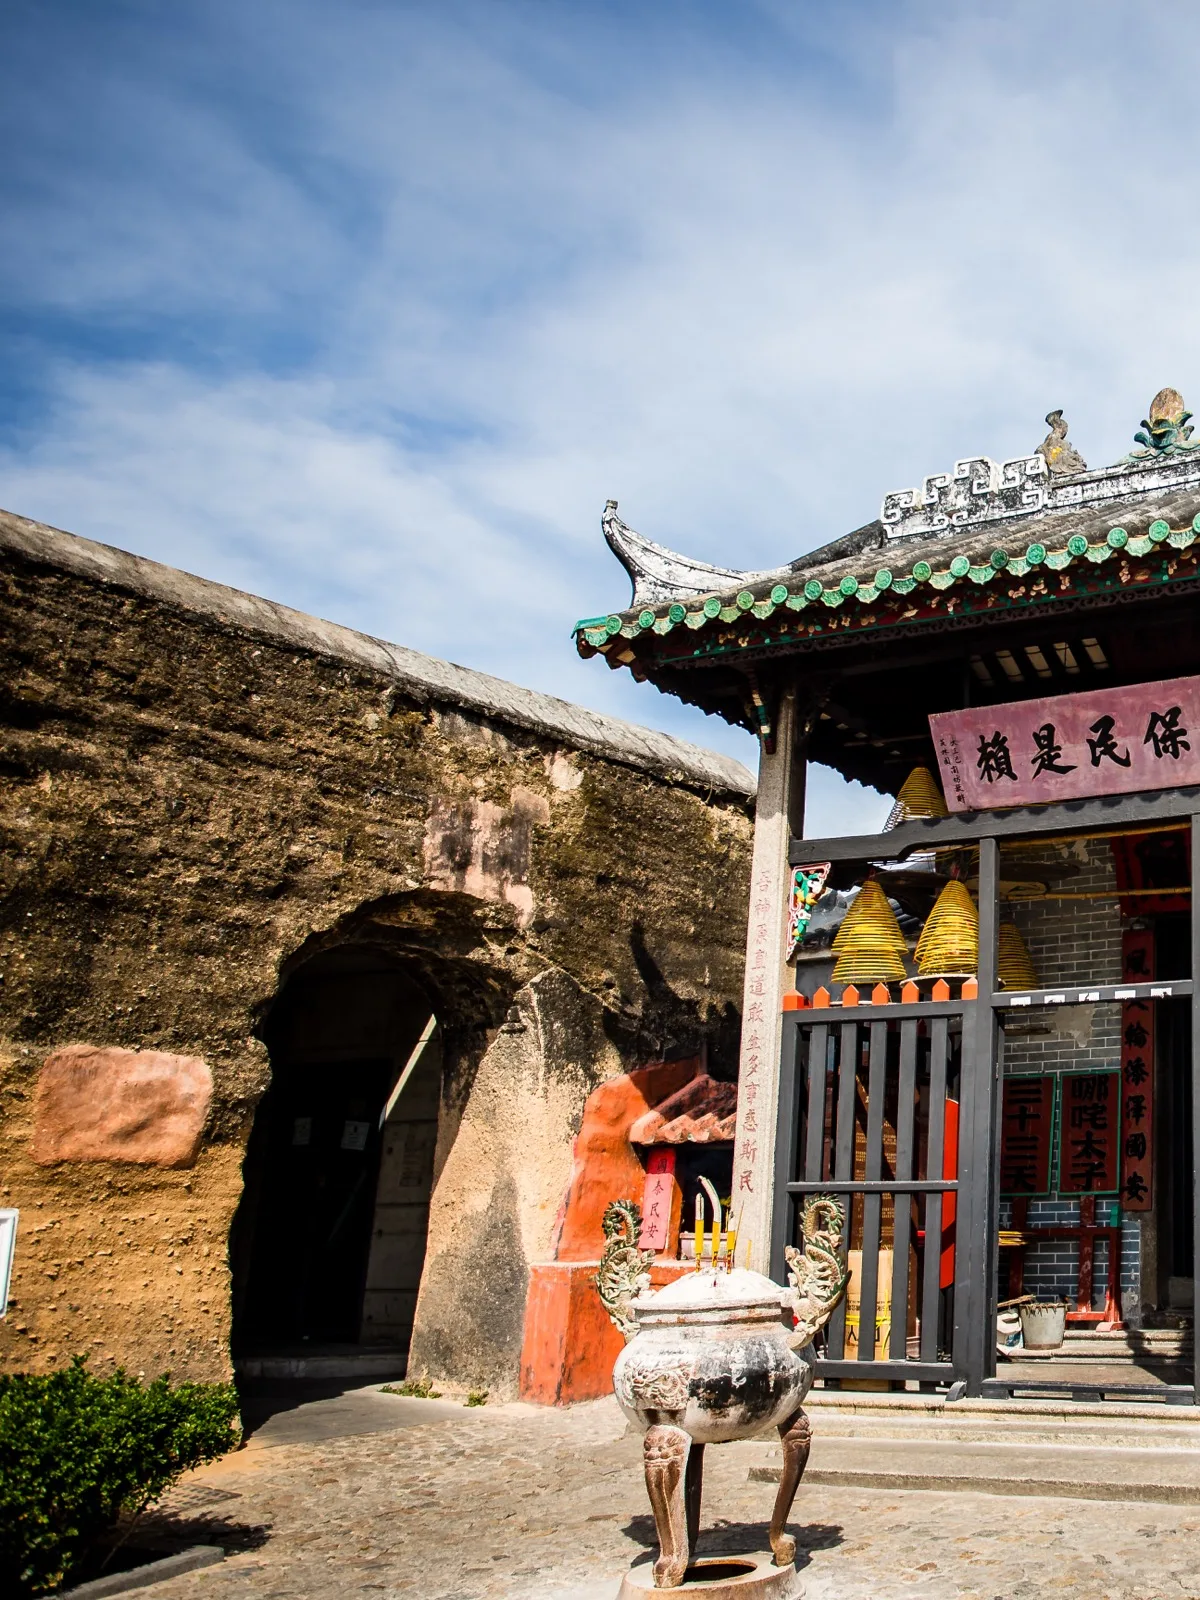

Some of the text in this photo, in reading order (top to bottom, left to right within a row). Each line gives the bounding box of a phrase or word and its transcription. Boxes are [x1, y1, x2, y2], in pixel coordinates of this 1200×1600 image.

[1003, 1078, 1042, 1192] 三十三天
[645, 1158, 668, 1239] 國泰民安
